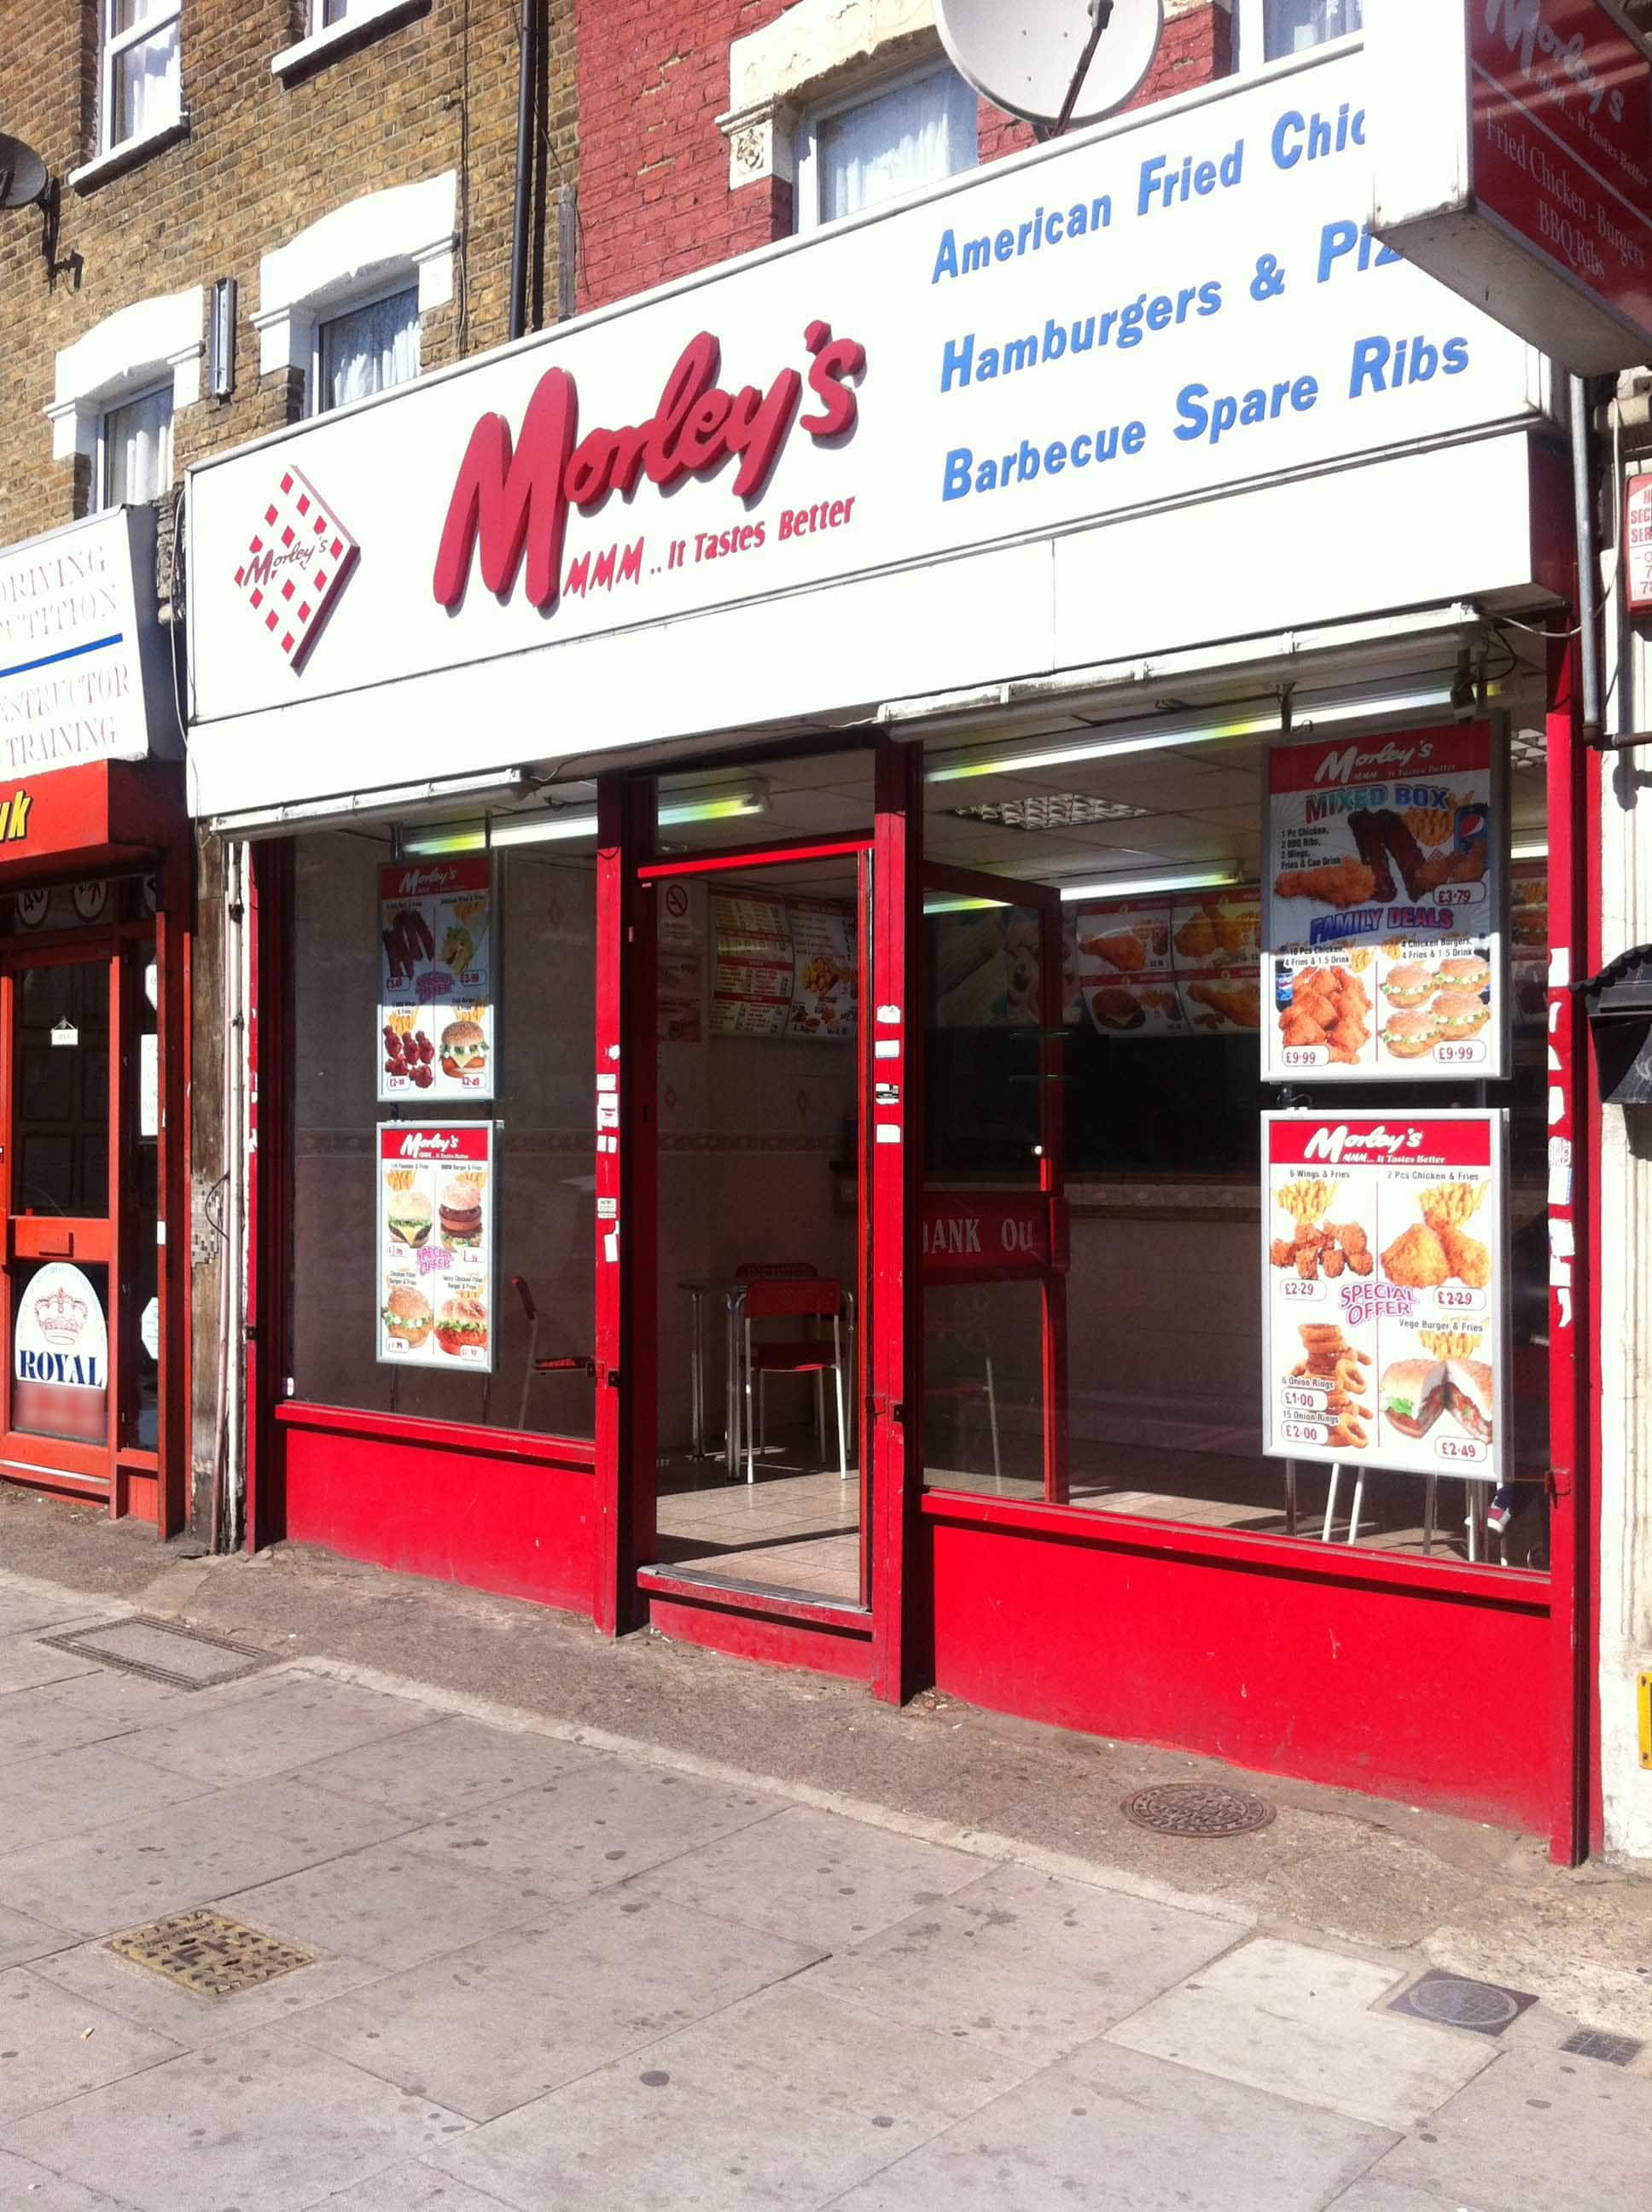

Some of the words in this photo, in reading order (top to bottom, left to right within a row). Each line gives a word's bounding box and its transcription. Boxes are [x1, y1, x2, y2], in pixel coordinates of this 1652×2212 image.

[1486, 107, 1527, 171] Fried
[1530, 145, 1587, 221] Chicken
[1597, 202, 1645, 270] Burgers
[933, 195, 1111, 284] American
[1138, 140, 1242, 215] Fried
[1539, 200, 1577, 266] BBQ
[1577, 232, 1605, 280] Ribs
[939, 278, 1222, 393] Hamburgers
[1250, 254, 1284, 302] &
[942, 422, 1146, 502] Barbecue
[1173, 375, 1318, 445] Spare
[1349, 335, 1469, 398] Ribs
[433, 319, 867, 610] Morley's
[669, 537, 686, 569] It
[695, 520, 765, 565] Tastes
[778, 495, 855, 542] Better
[243, 535, 329, 586] Morley's
[6, 717, 116, 767] TRAINING
[1314, 740, 1434, 784] Morley's
[1305, 784, 1387, 825] MIXED
[1395, 784, 1450, 810] BOX
[1310, 907, 1384, 946] FAMILY
[1387, 907, 1454, 929] DEALS
[1291, 958, 1309, 966] Fries
[1331, 955, 1350, 964] Drink
[1409, 950, 1428, 958] Fries
[1452, 947, 1473, 957] Drink
[399, 1132, 459, 1158] Morley's
[1304, 1125, 1424, 1163] Morley's
[1296, 1170, 1320, 1179] Wings
[1331, 1170, 1350, 1179] Fries
[1412, 1171, 1446, 1180] Chicken
[1457, 1172, 1479, 1180] Fries
[1340, 1284, 1417, 1307] SPECIAL
[1347, 1301, 1411, 1325] OFFER
[1422, 1319, 1450, 1331] Burger
[1462, 1322, 1483, 1332] Fries
[20, 1349, 103, 1388] ROYAL
[1288, 1376, 1311, 1386] Onion
[1312, 1378, 1334, 1390] Rings
[1283, 1411, 1292, 1419] 15
[1294, 1411, 1316, 1421] Onion
[1318, 1412, 1339, 1424] Rings
